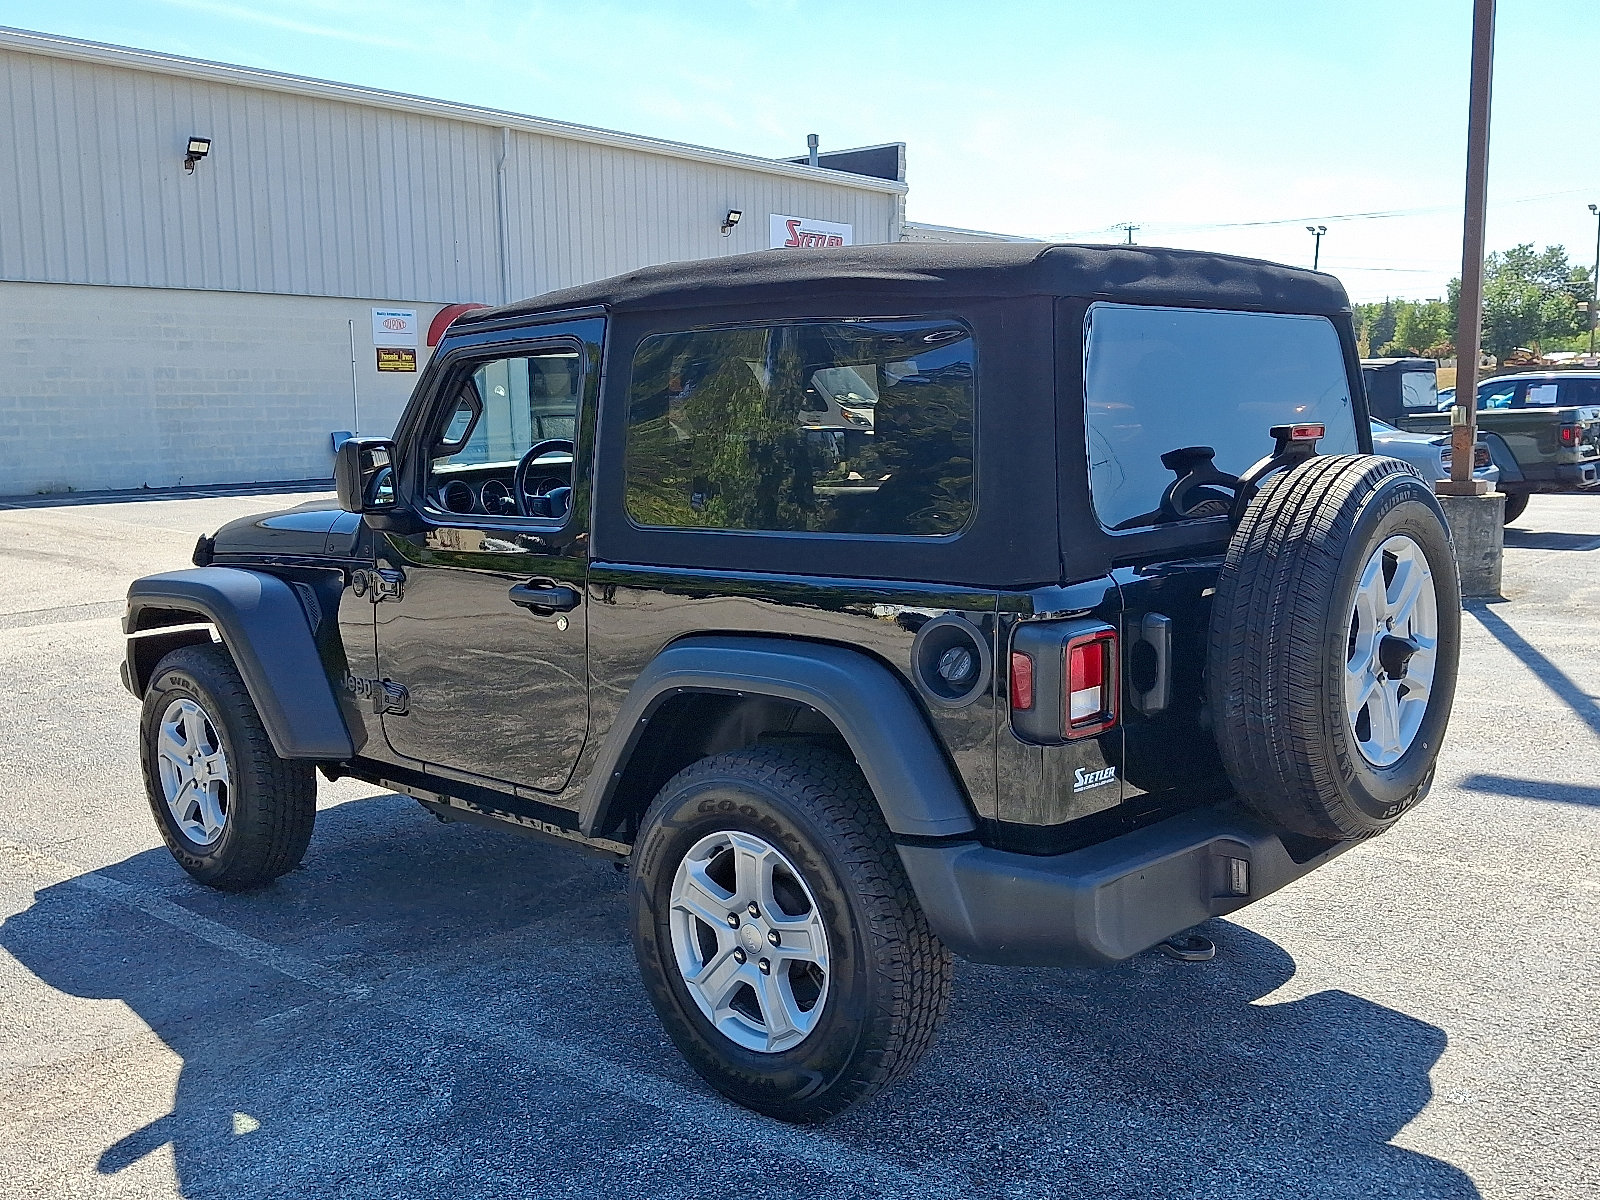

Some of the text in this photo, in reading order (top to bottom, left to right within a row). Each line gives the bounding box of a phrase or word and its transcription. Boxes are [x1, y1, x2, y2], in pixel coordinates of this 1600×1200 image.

[784, 219, 844, 247] STETLER
[341, 670, 372, 695] Jeep
[1074, 766, 1116, 788] STETLER
